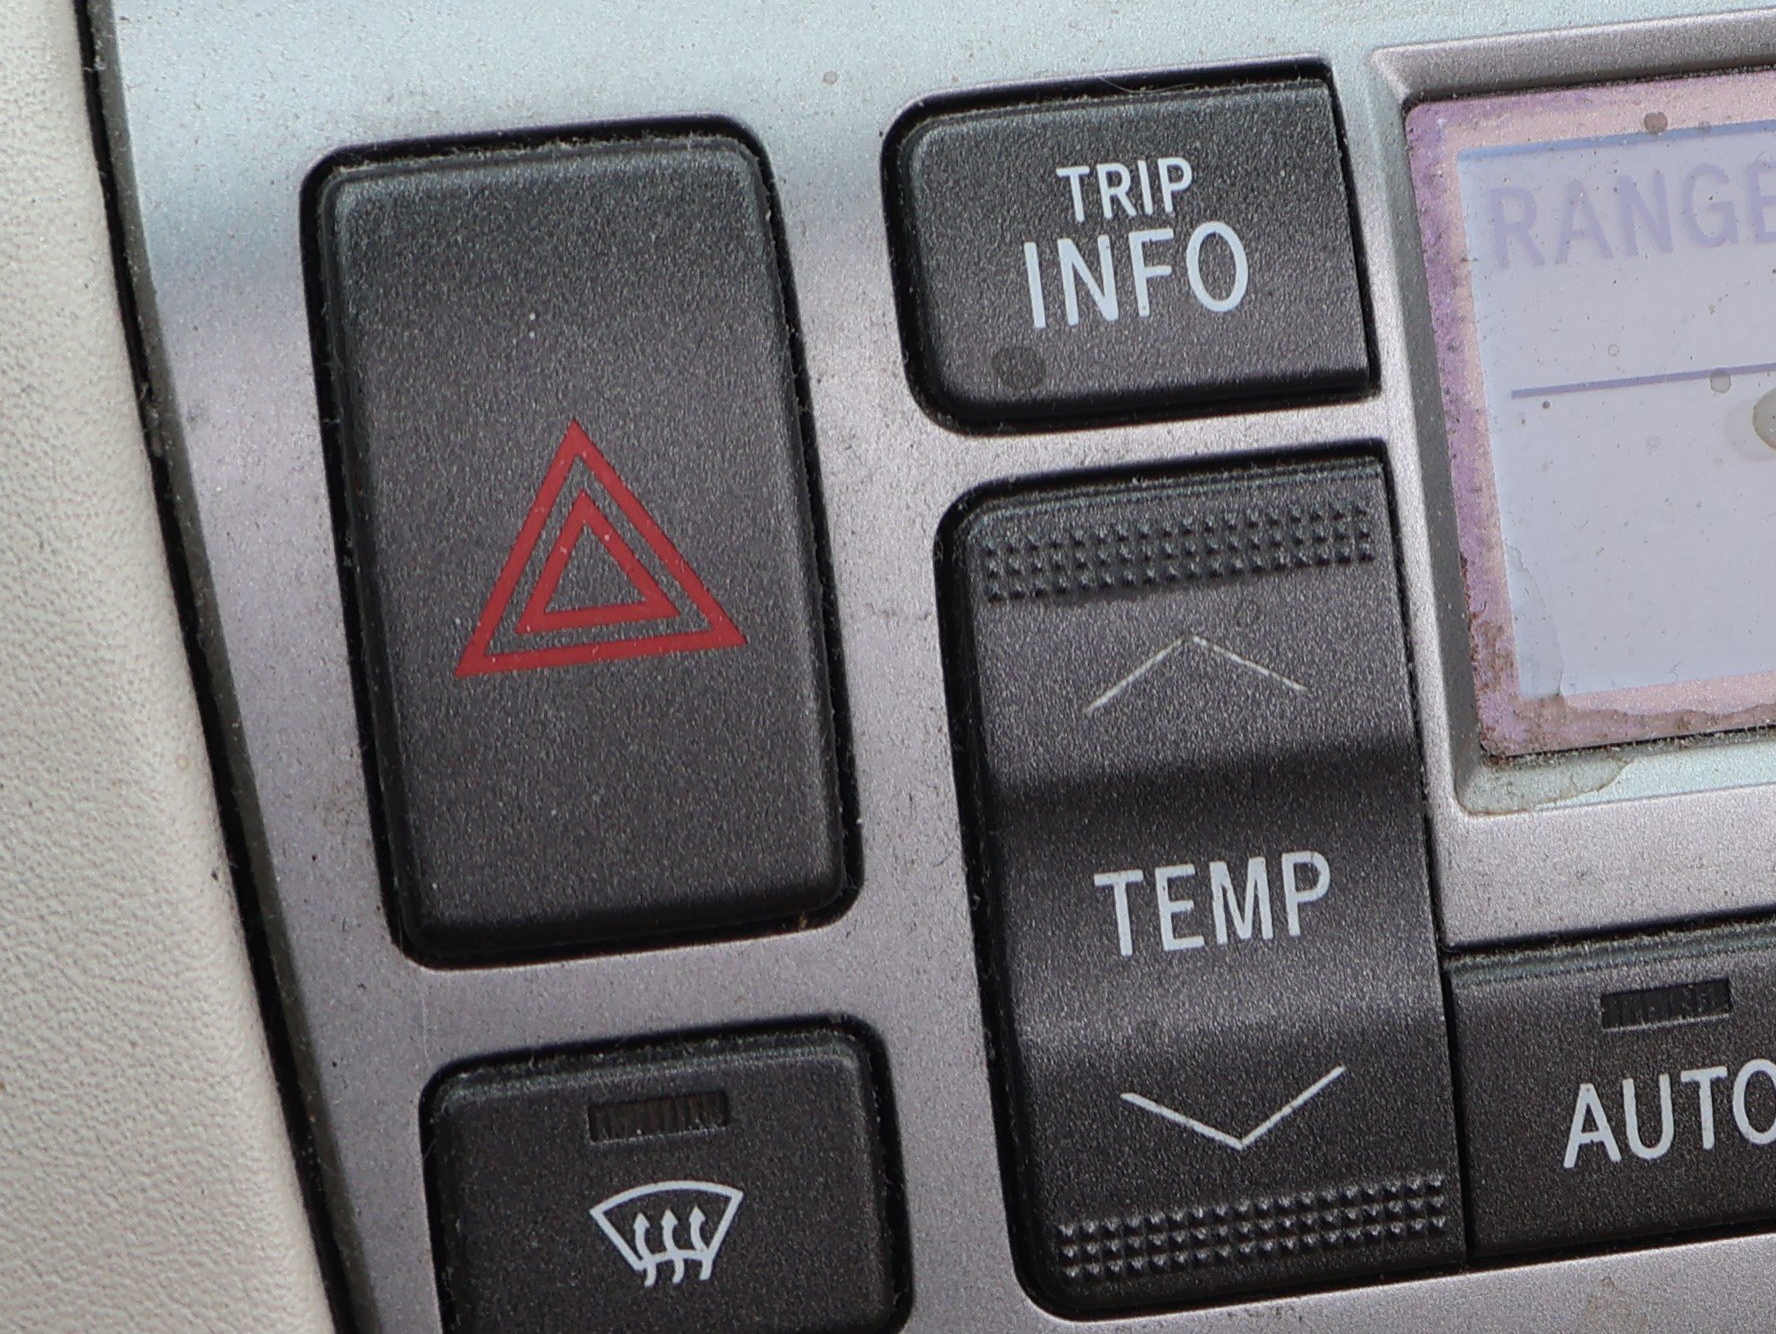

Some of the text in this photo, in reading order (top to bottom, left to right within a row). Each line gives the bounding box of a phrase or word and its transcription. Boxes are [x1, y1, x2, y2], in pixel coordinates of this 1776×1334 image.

[1056, 155, 1196, 225] TRIP
[1021, 219, 1250, 331] INFO
[1093, 849, 1334, 958] TEMP
